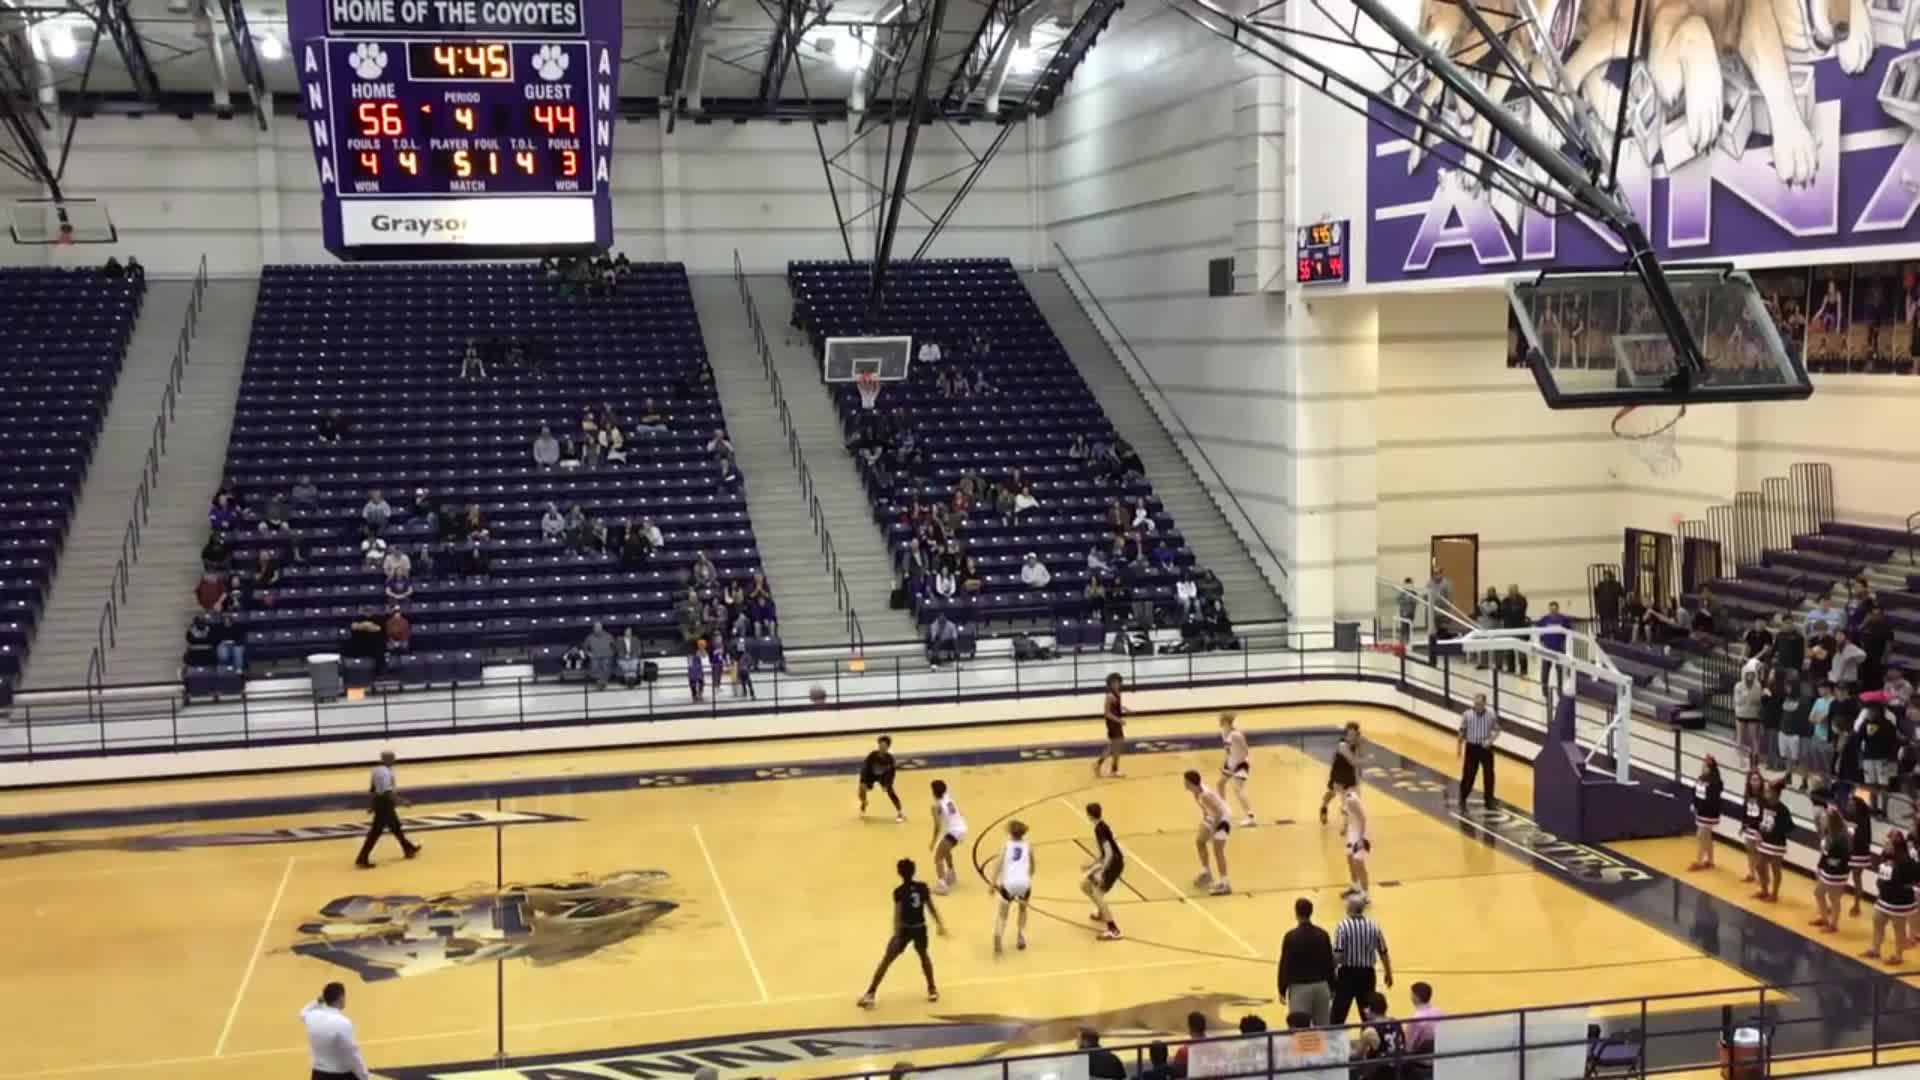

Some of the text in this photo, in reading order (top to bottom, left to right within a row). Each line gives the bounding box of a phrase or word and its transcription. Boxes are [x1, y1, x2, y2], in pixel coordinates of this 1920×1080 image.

[333, 0, 577, 25] HOME OF THE COYOTES
[434, 44, 508, 78] 4:45
[351, 83, 396, 99] HOME
[444, 92, 481, 104] PERIOD
[524, 84, 572, 100] GUEST
[358, 103, 403, 136] 56
[455, 108, 474, 131] 4
[533, 104, 576, 134] 44
[347, 139, 381, 150] FOULS
[430, 139, 499, 150] PLAYER FOUL
[548, 139, 580, 150] FOULS
[361, 152, 378, 175] 4
[399, 152, 418, 175] 4
[516, 151, 535, 175] 4
[562, 151, 577, 176] 3
[355, 181, 380, 192] WON
[450, 180, 486, 192] MATCH
[555, 180, 578, 191] WON
[371, 214, 467, 238] Grayso
[1012, 846, 1024, 862] 3
[910, 891, 921, 909] 3
